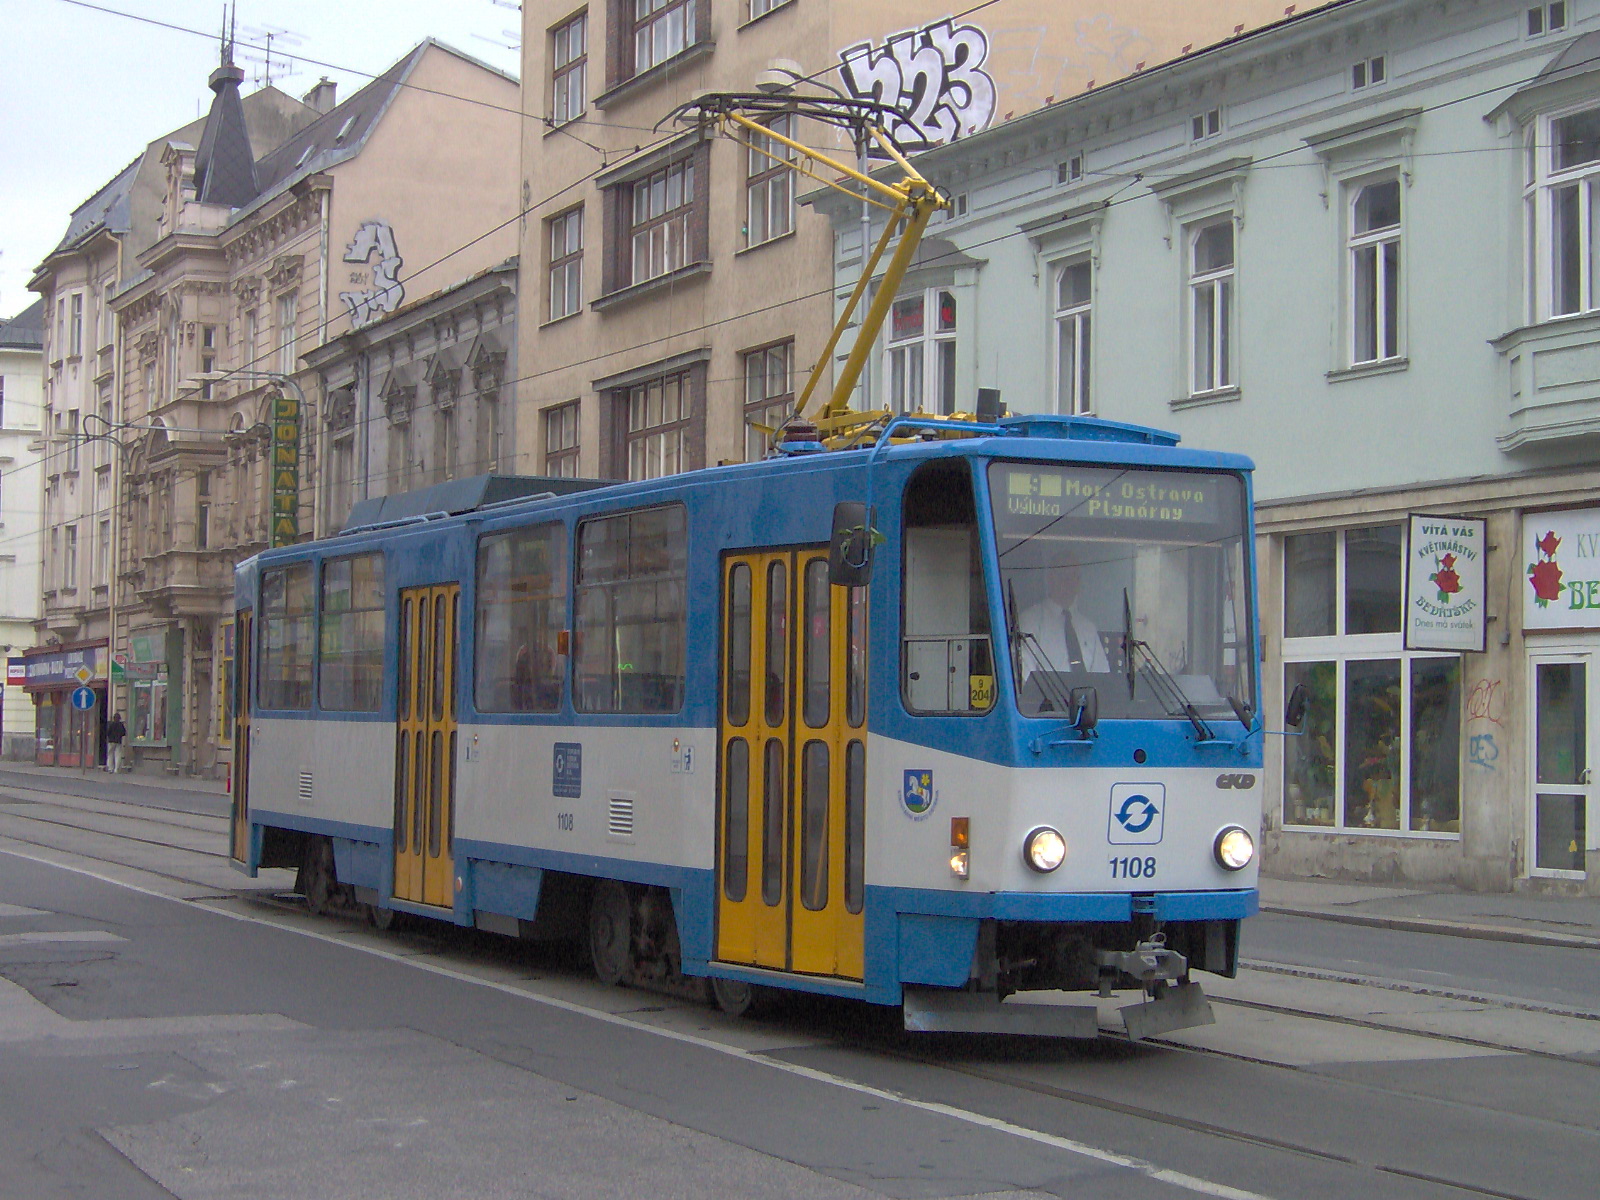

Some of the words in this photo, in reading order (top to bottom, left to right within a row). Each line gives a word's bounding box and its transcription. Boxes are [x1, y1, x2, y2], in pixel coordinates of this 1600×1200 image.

[274, 400, 298, 548] JONATA
[1066, 479, 1111, 498] Mor.
[1121, 482, 1204, 503] Ostrava
[1088, 499, 1183, 520] Plynárny
[1422, 524, 1448, 536] VÍTÁ
[1452, 525, 1474, 538] VÁS
[1418, 540, 1477, 561] KVĚTINÁŘSTVÍ
[1415, 618, 1434, 628] Dnes
[1436, 619, 1448, 629] má
[1450, 619, 1474, 629] svátek
[972, 690, 989, 701] 204
[557, 813, 574, 831] 1108
[1109, 856, 1157, 879] 1108
